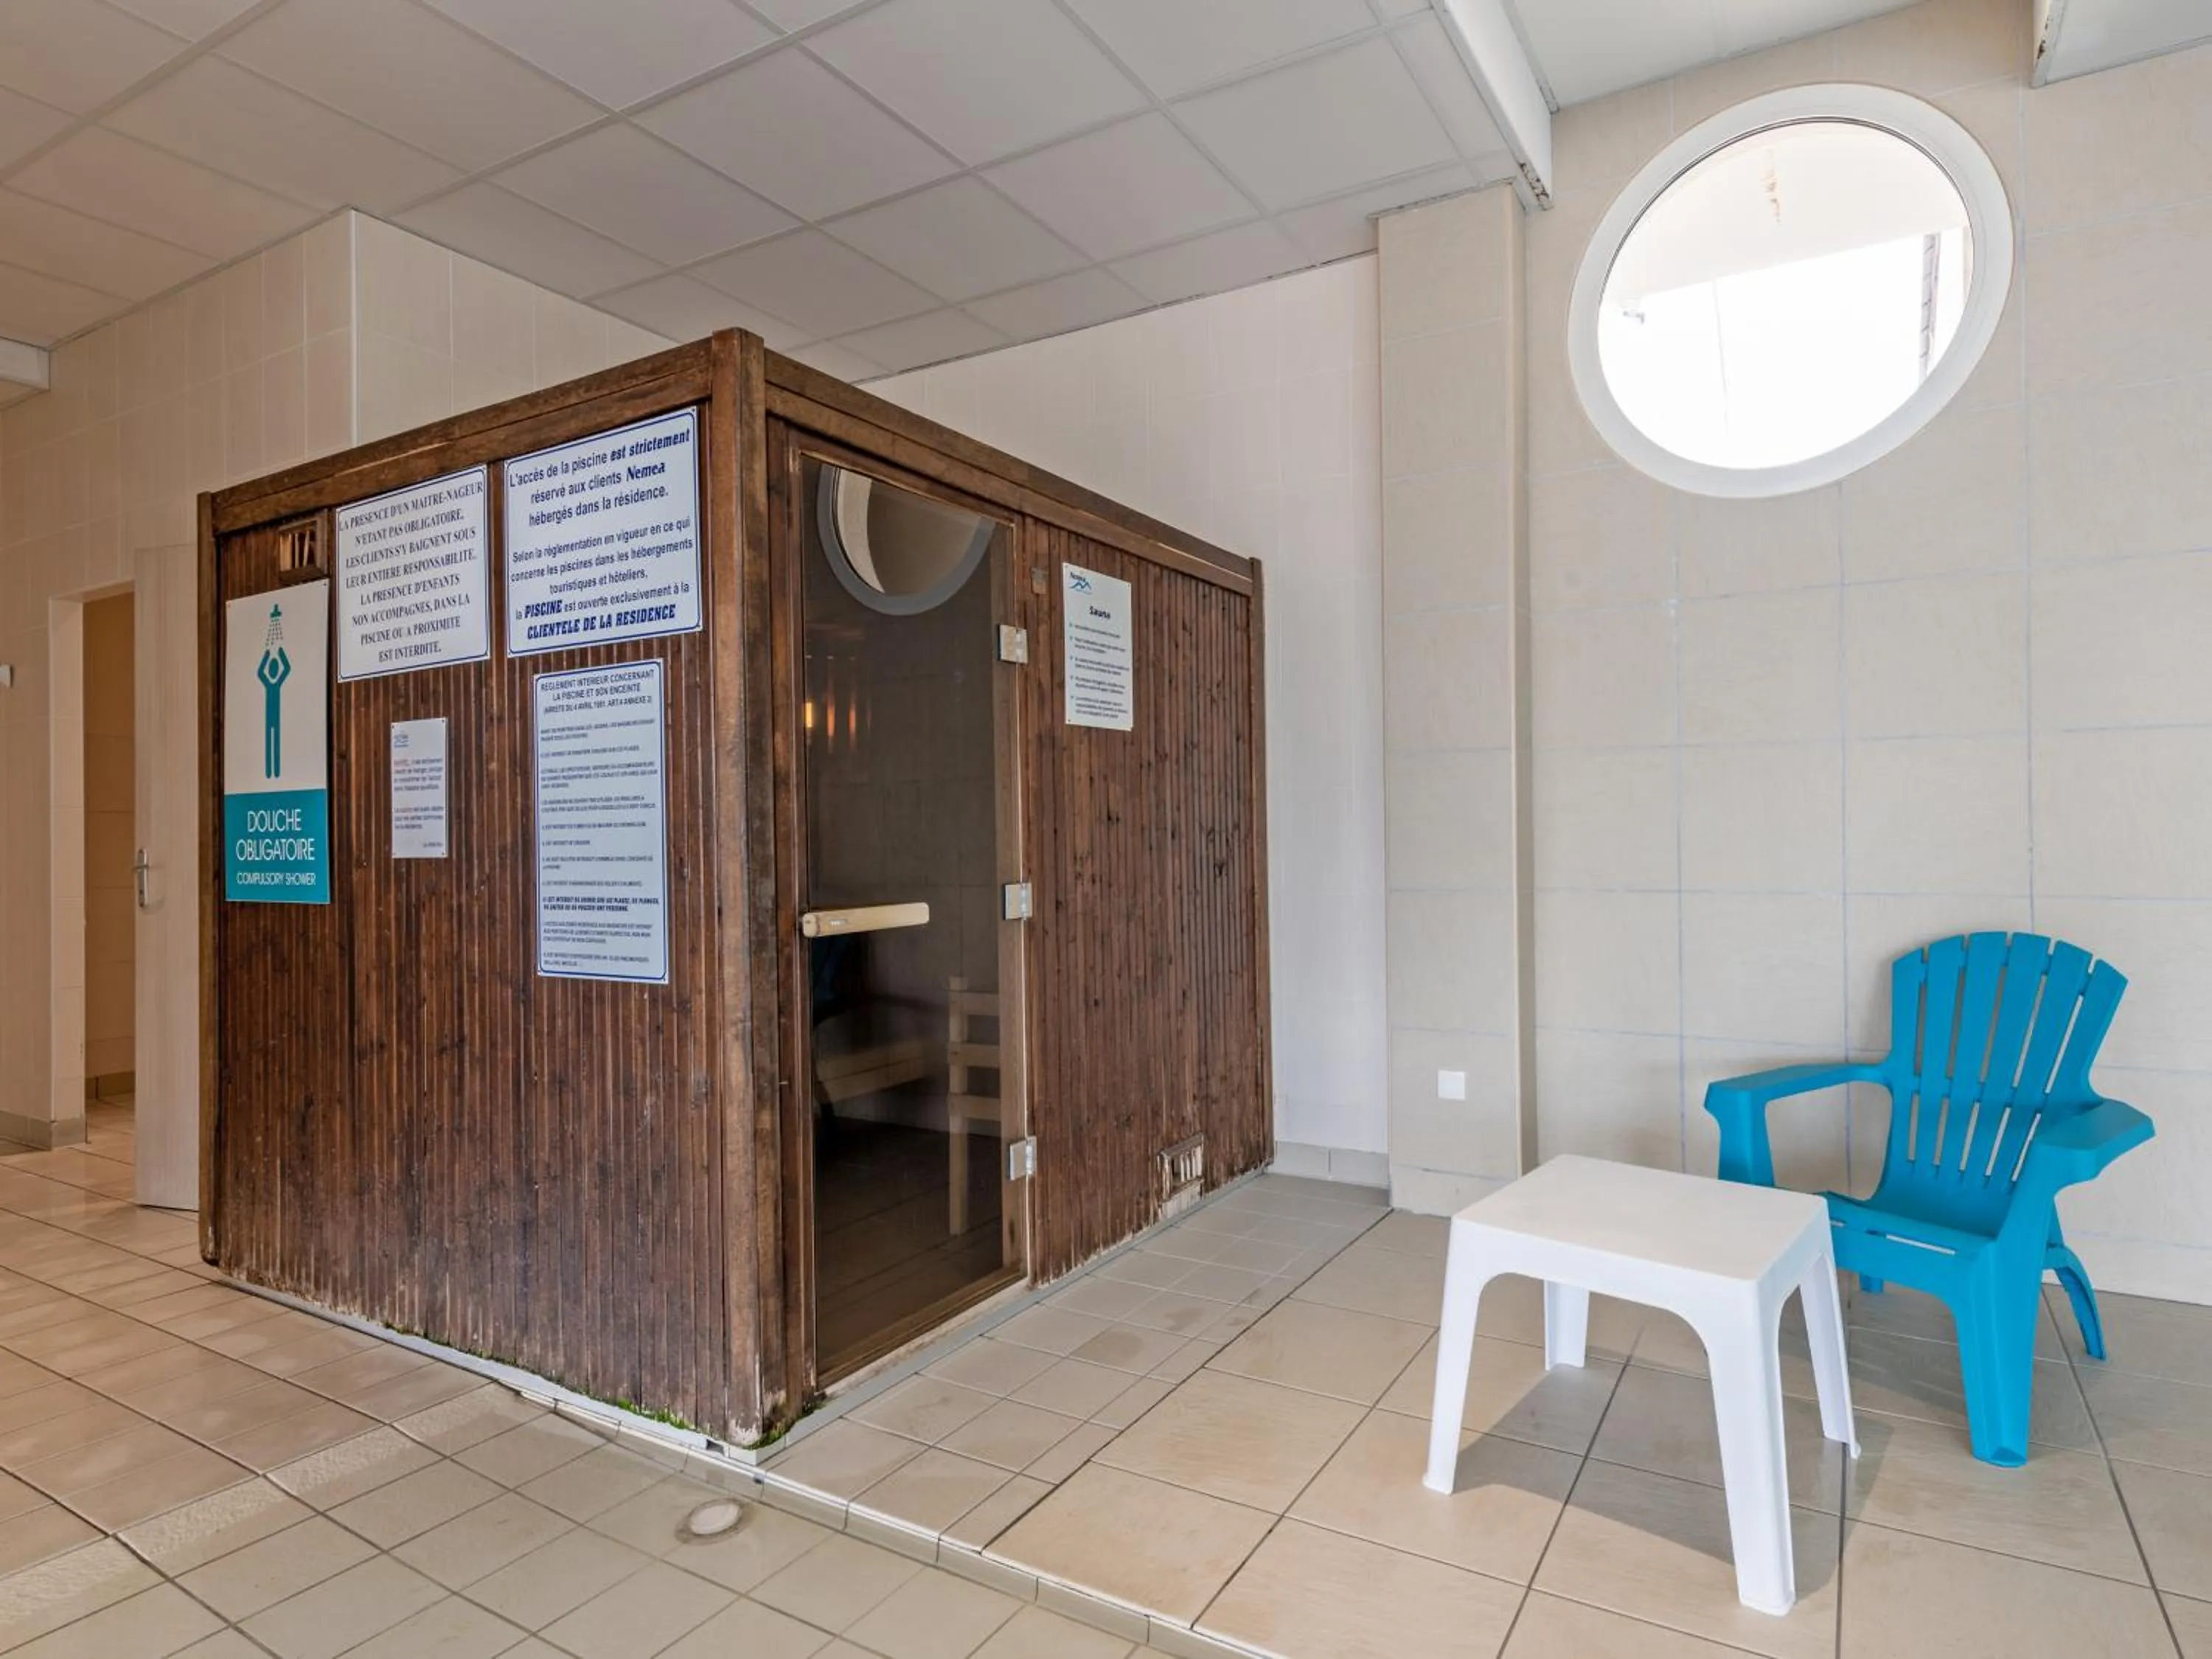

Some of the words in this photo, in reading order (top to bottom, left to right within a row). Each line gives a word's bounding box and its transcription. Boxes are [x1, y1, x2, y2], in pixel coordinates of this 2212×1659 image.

[546, 464, 558, 478] de
[561, 461, 569, 473] la
[572, 452, 607, 475] piscine
[611, 445, 626, 462] est
[629, 428, 690, 456] strictement
[531, 483, 566, 504] réservé
[568, 481, 586, 495] aux
[588, 472, 622, 490] clients
[626, 462, 666, 481] Nemea
[339, 520, 349, 532] LA
[350, 507, 389, 529] PRESENCE
[411, 481, 484, 510] MAITRE-NAGEUR
[529, 505, 573, 526] hébergés
[576, 501, 599, 516] dans
[602, 496, 611, 510] la
[614, 486, 669, 507] résidence.
[346, 556, 360, 568] LES
[361, 548, 394, 565] CLIENTS
[409, 532, 451, 553] BAIGNENT
[453, 526, 476, 541] SOUS
[389, 524, 403, 538] PAS
[512, 550, 534, 563] Selon
[535, 547, 542, 558] la
[604, 534, 614, 545] en
[616, 527, 648, 543] vigueur
[650, 524, 661, 535] en
[663, 521, 674, 532] ce
[676, 516, 691, 532] qui
[510, 568, 545, 582] concerne
[546, 564, 558, 576] les
[560, 558, 594, 575] piscines
[595, 554, 614, 566] dans
[617, 551, 629, 560] les
[631, 538, 693, 559] hébergements
[346, 574, 366, 588] LEUR
[368, 566, 401, 583] ENTIERE
[361, 594, 371, 605] LA
[372, 584, 412, 602] PRESENCE
[414, 574, 459, 594] D'ENFANTS
[549, 577, 597, 594] touristiques
[599, 574, 607, 585] et
[352, 613, 369, 625] NON
[434, 596, 456, 611] DANS
[458, 593, 470, 605] LA
[524, 599, 563, 619] PISCINE
[564, 599, 577, 612] est
[577, 596, 608, 610] ouverte
[610, 585, 672, 605] exclusivement
[681, 581, 689, 593] la
[361, 629, 391, 646] PISCINE
[413, 616, 460, 636] PROXIMITE
[527, 619, 580, 639] CLIENTELE
[583, 616, 597, 631] DE
[599, 613, 613, 629] LA
[615, 603, 676, 627] RESIDENCE
[378, 649, 393, 662] EST
[247, 809, 302, 832] DOUCHE
[236, 838, 315, 861] OBLIGATOIRE
[237, 872, 284, 886] COMPULSORY
[285, 872, 316, 886] SHOWER
